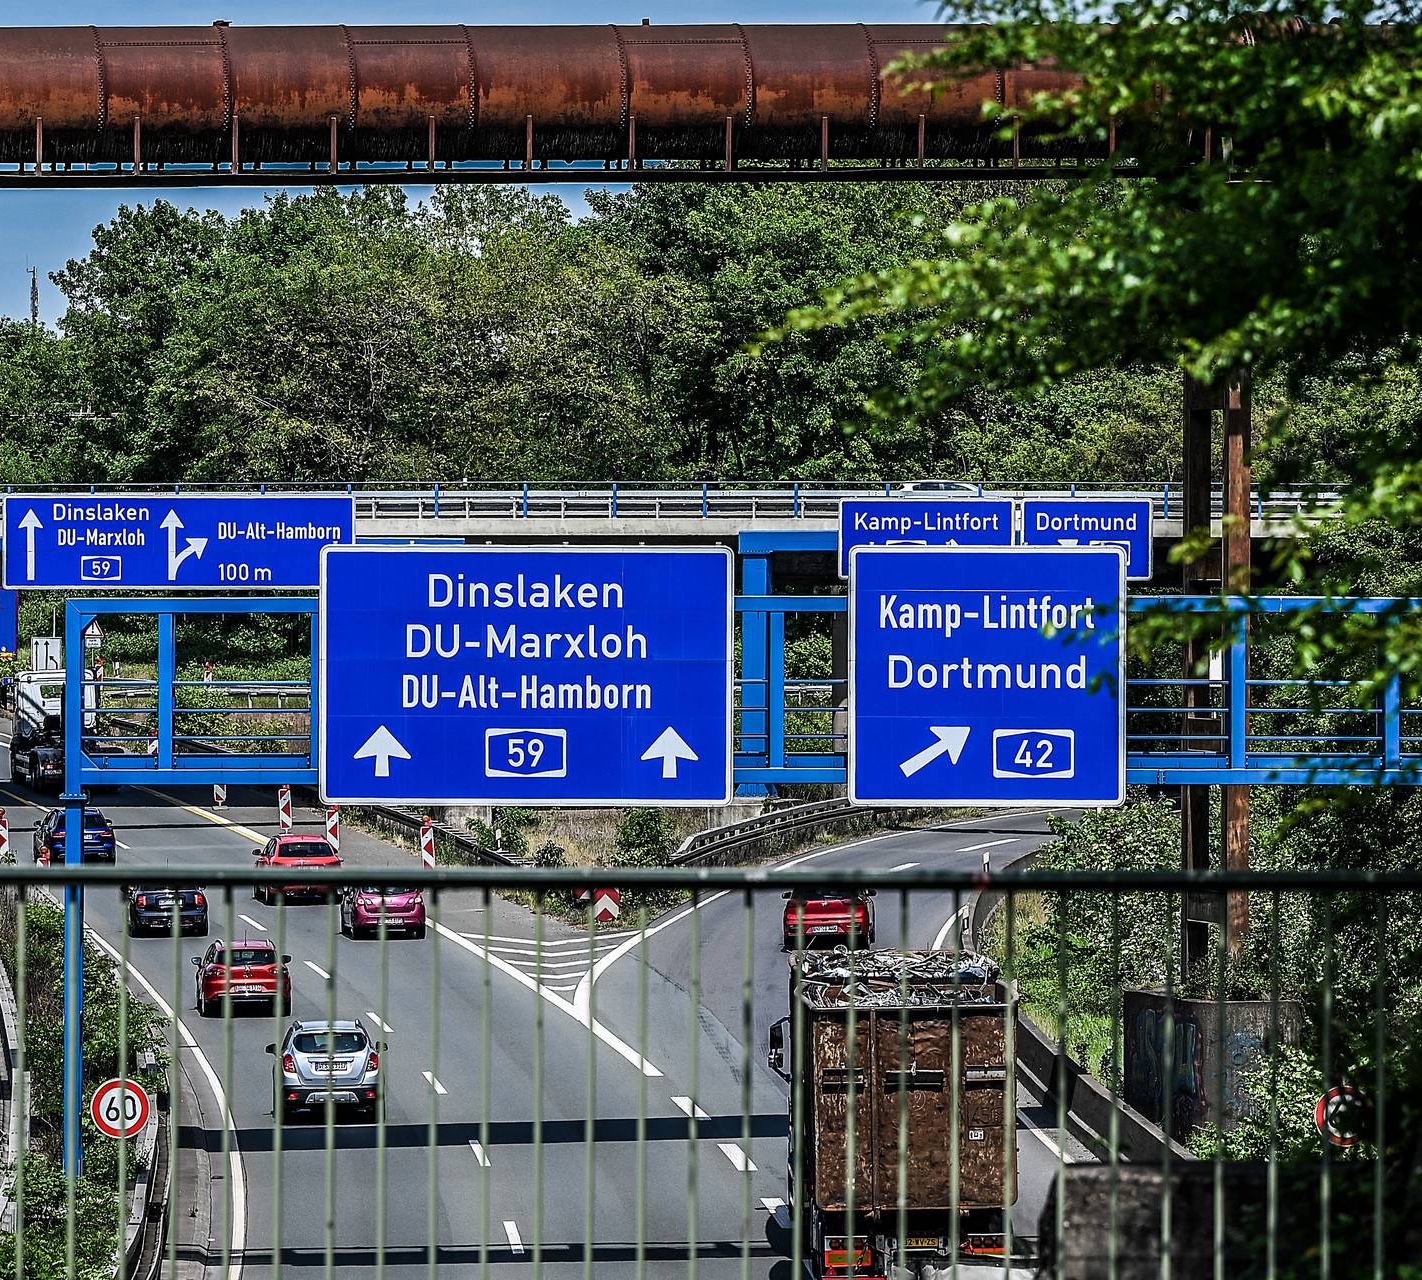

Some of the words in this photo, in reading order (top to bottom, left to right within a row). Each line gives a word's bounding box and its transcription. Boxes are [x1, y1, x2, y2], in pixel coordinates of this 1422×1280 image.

[53, 503, 150, 521] Dinslaken
[854, 512, 999, 535] Kamp-Lintfort
[1036, 511, 1138, 531] Dortmund
[57, 528, 145, 546] DU-Marxloh
[218, 521, 341, 540] DU-Alt-Hamborn
[91, 561, 111, 576] 59
[218, 563, 249, 581] 100
[254, 567, 272, 581] m
[428, 573, 623, 608] Dinslaken
[879, 594, 1095, 638] Kamp-Lintfort
[406, 623, 647, 659] DU-Marxloh
[888, 654, 1086, 689] Dortmund
[402, 674, 651, 710] DU-Alt-Hamborn
[508, 738, 544, 768] 59
[1014, 739, 1053, 768] 42
[106, 1095, 137, 1121] 60
